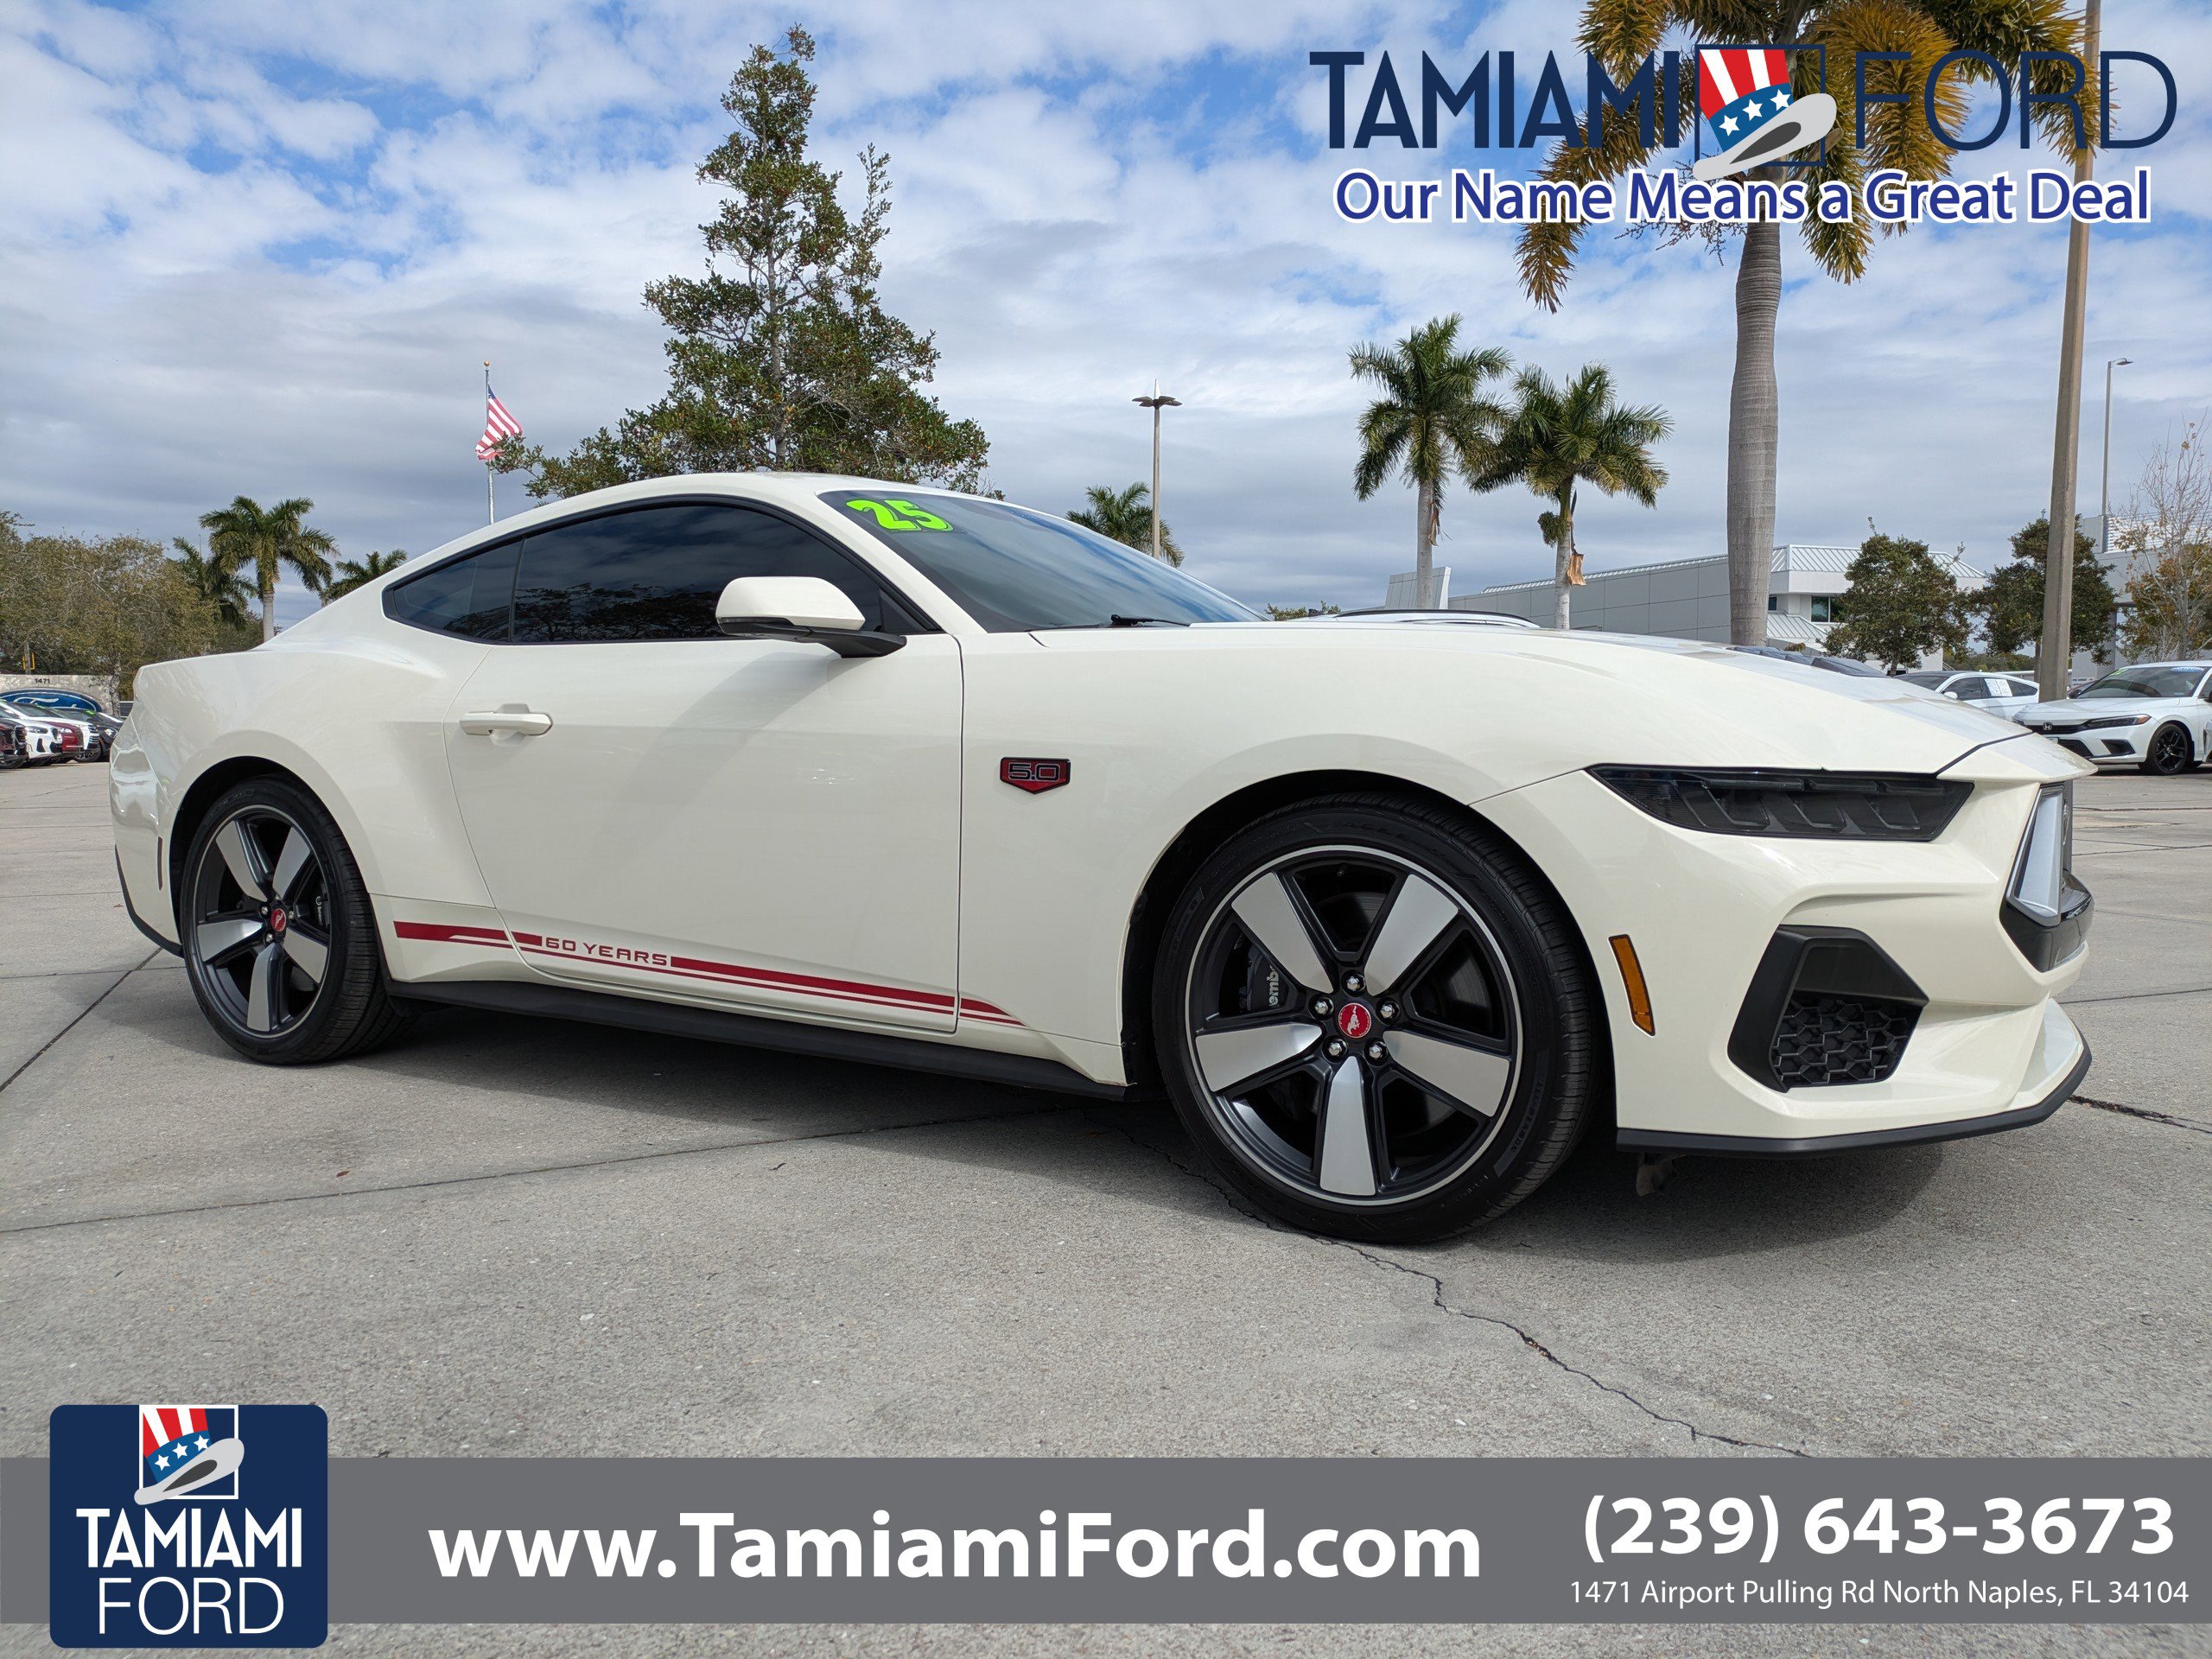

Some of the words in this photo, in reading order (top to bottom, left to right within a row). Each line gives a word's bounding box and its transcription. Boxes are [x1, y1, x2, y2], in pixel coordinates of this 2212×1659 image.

[846, 499, 954, 531] 25
[1007, 761, 1061, 783] 5.0
[545, 937, 576, 952] 60
[582, 942, 668, 966] YEARS
